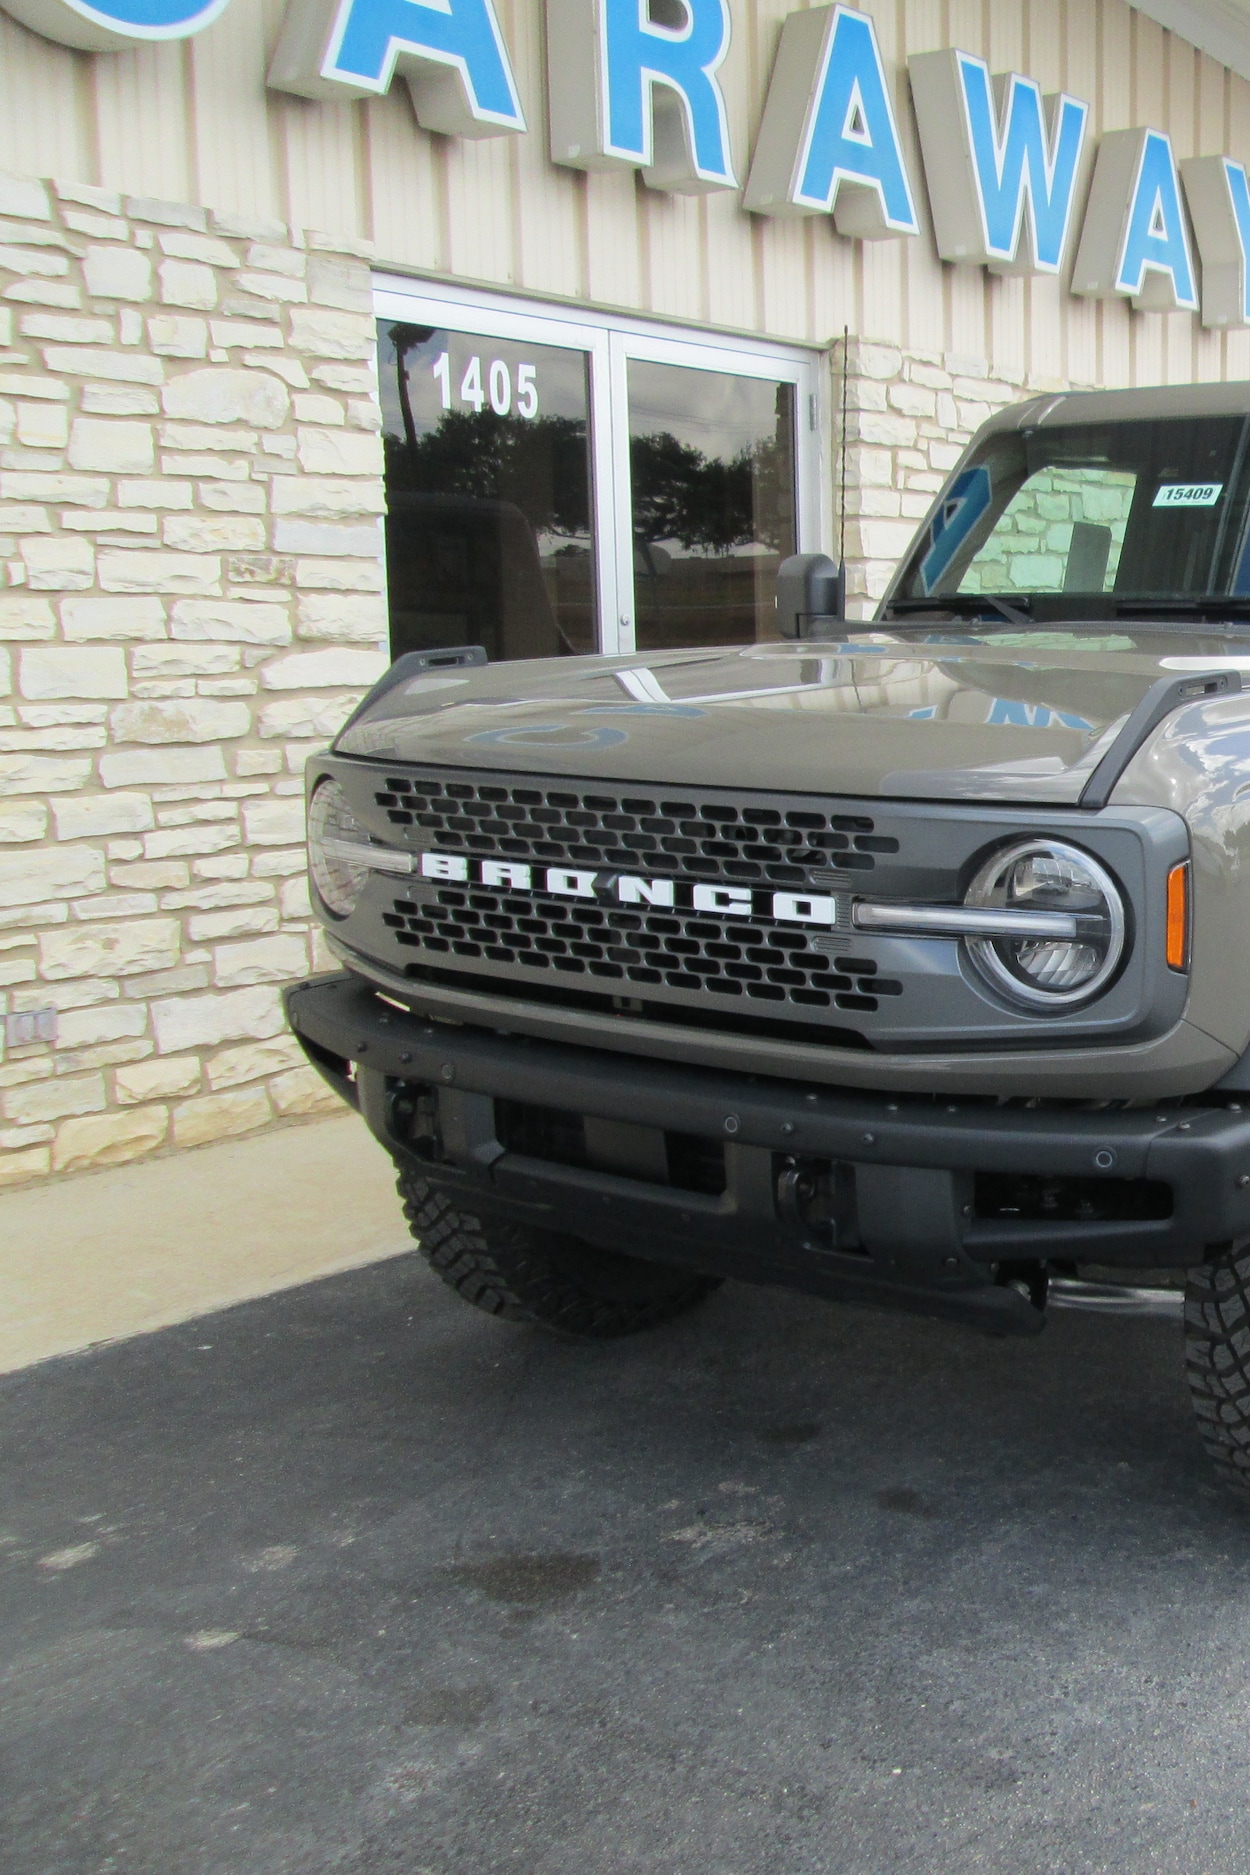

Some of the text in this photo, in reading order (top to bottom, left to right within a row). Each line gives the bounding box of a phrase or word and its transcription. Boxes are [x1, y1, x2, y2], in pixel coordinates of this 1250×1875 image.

[433, 351, 538, 418] 1405
[1166, 487, 1214, 500] 15409
[421, 852, 837, 926] BRONCO
